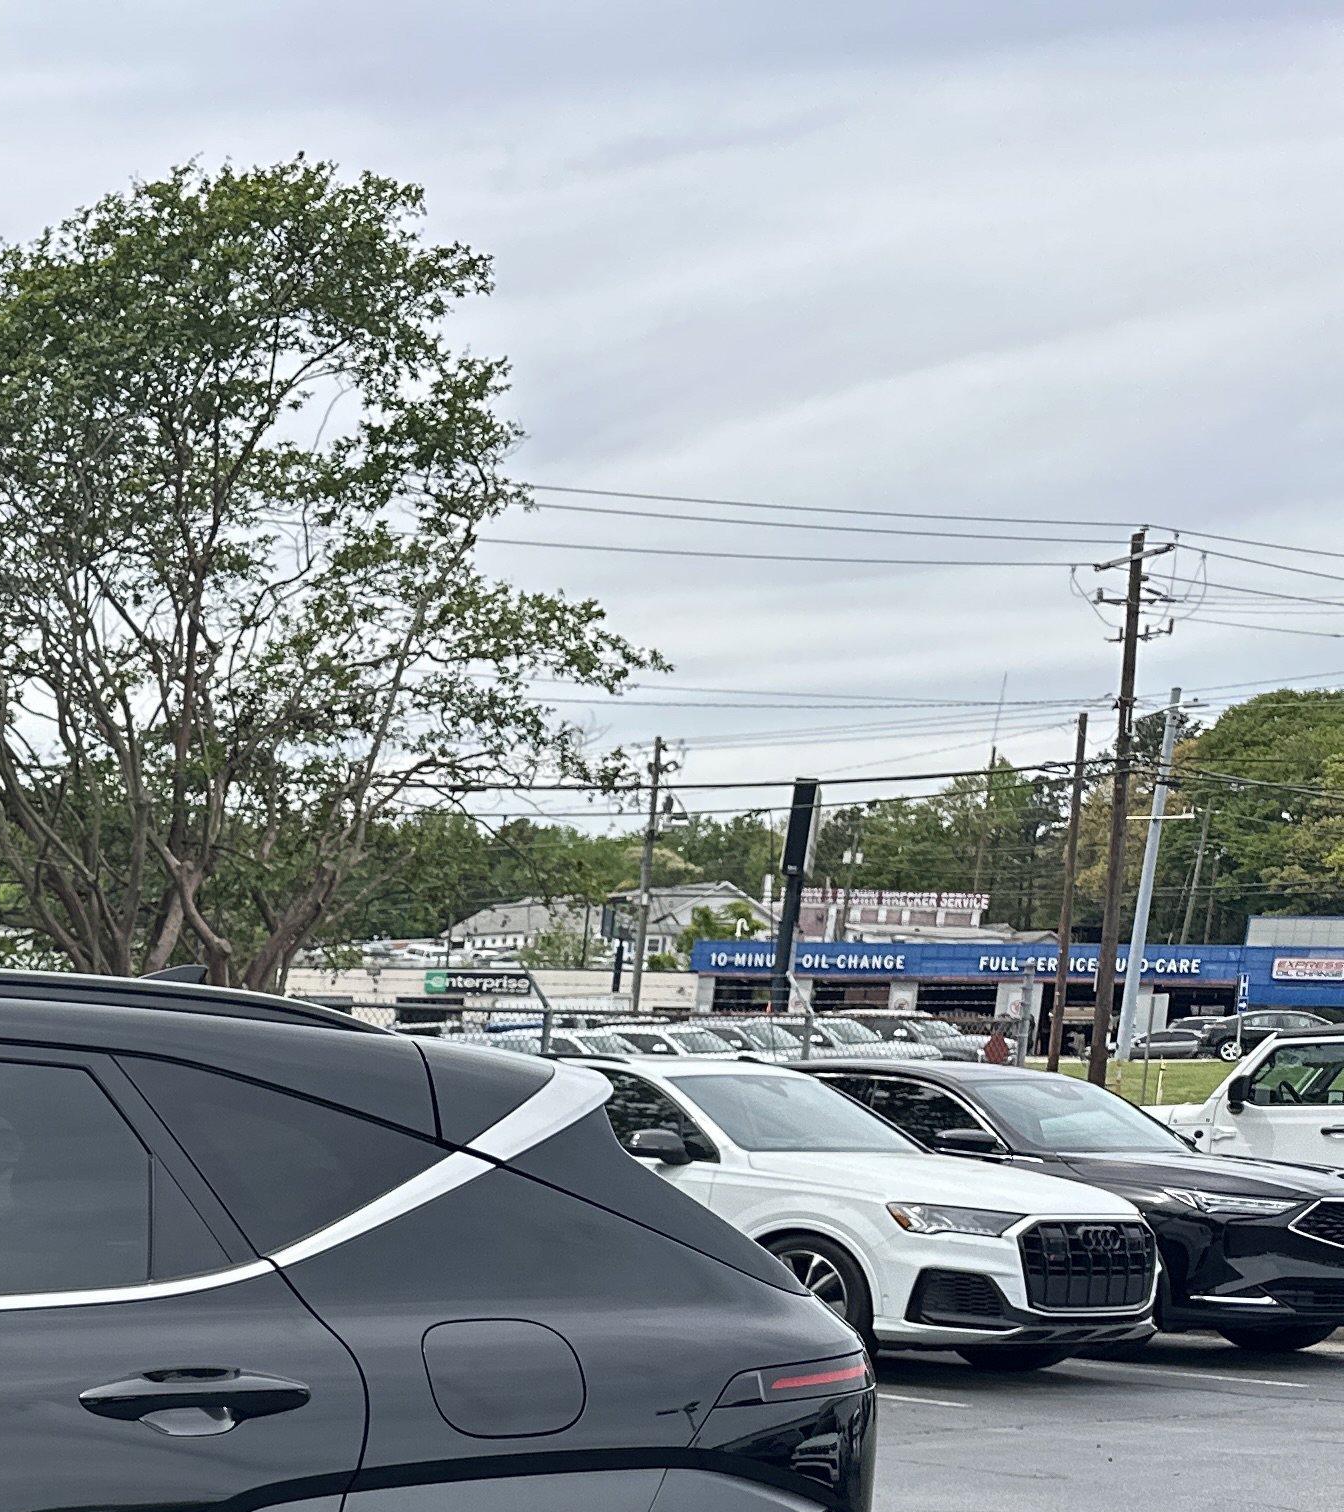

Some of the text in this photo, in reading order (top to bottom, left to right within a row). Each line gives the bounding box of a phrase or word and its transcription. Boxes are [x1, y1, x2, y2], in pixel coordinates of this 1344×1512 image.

[882, 891, 937, 907] WRECKER
[940, 892, 990, 909] SERVICE
[711, 952, 728, 966] 10
[801, 953, 830, 969] OIL
[836, 954, 905, 970] CHANGE
[979, 956, 1020, 971] FULL
[1155, 958, 1201, 973] CARE
[430, 975, 530, 991] enterprise
[1240, 974, 1249, 996] H
